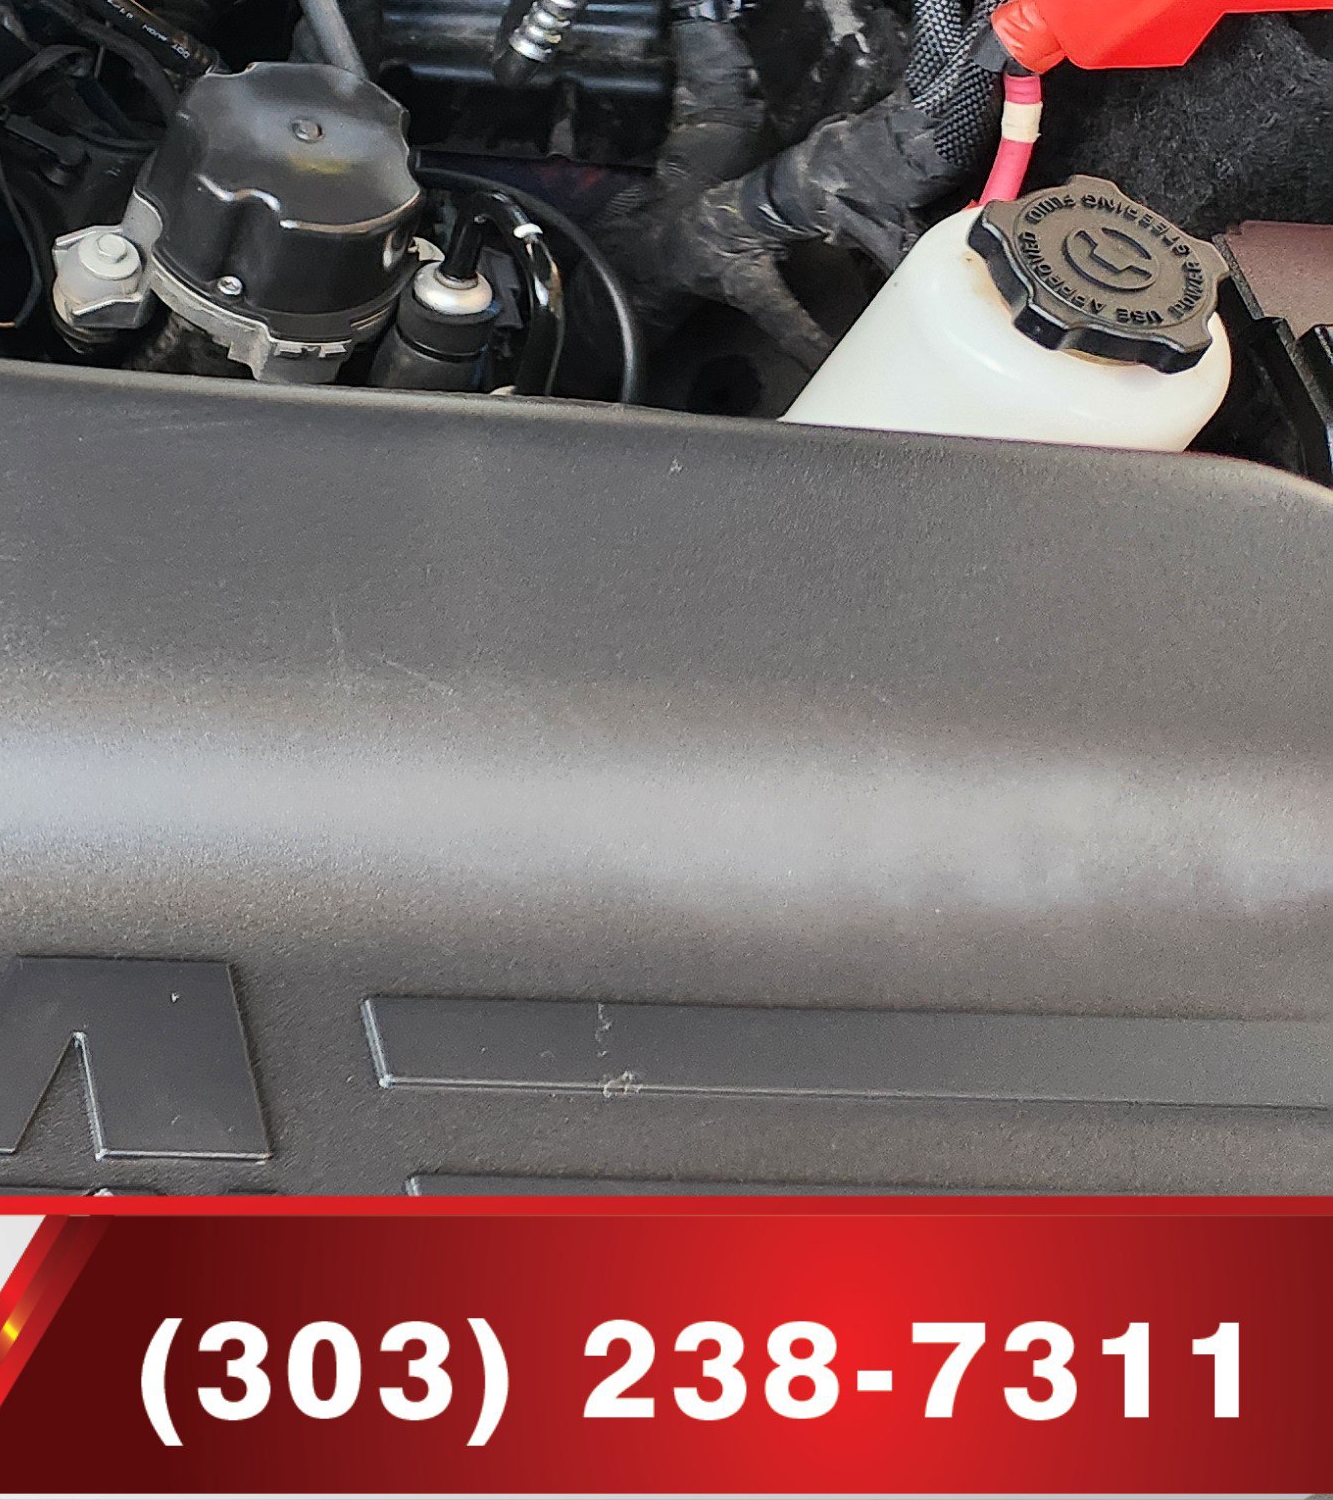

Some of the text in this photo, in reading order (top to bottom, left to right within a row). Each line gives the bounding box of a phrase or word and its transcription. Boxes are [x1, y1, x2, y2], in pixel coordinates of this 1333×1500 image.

[1017, 231, 1164, 325] USE APPROVED
[1024, 194, 1203, 320] POWER STEERING FLUID
